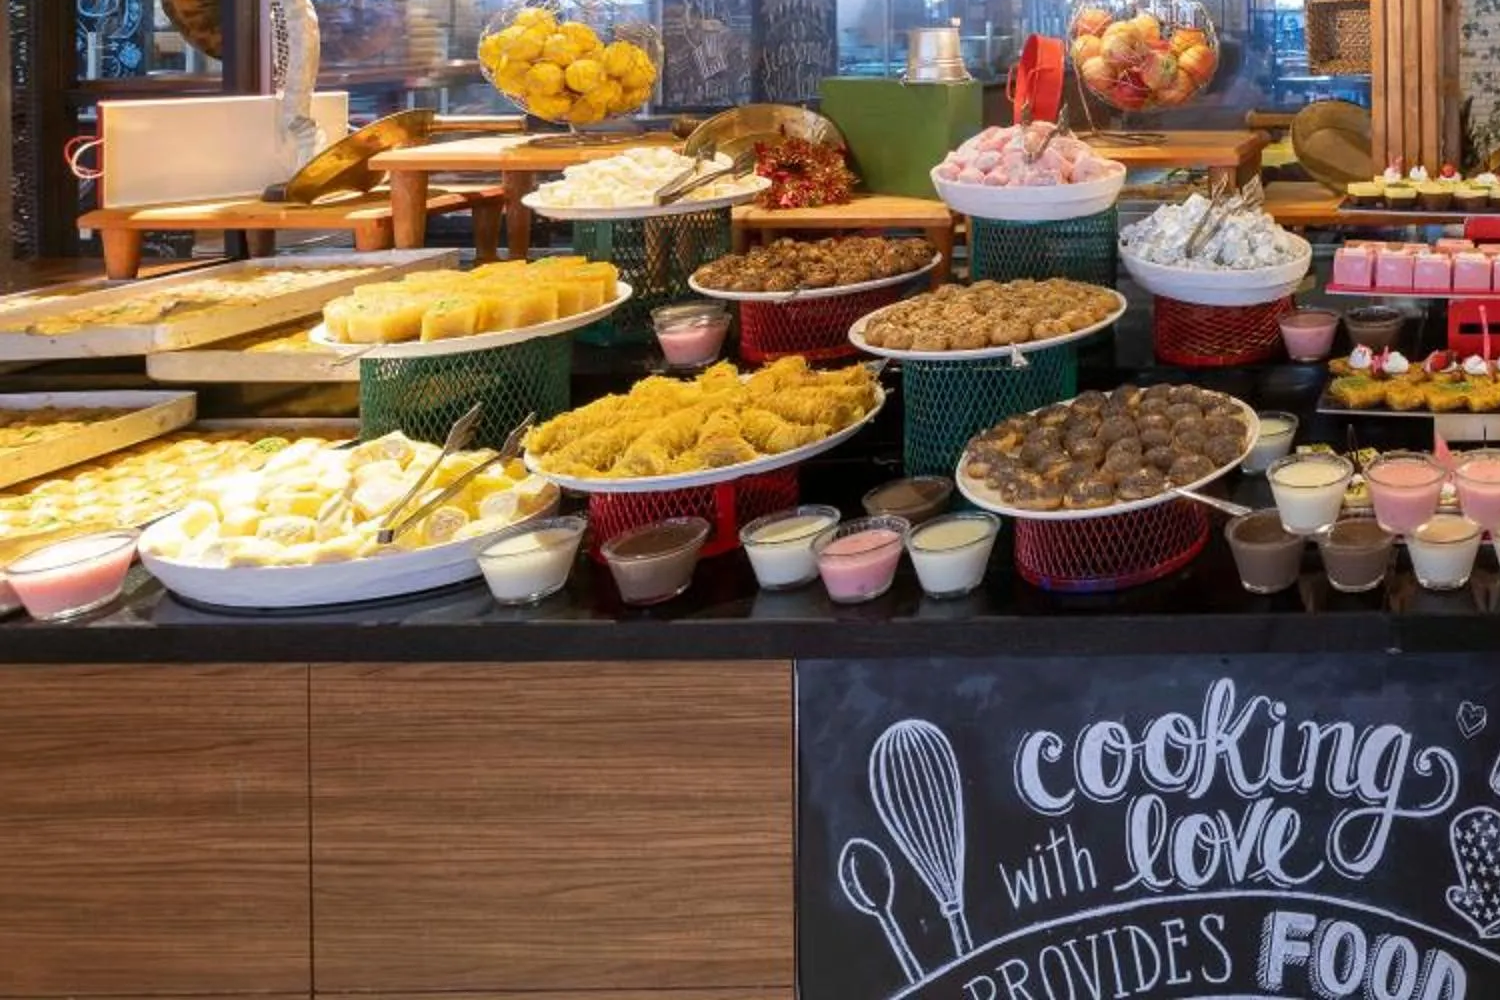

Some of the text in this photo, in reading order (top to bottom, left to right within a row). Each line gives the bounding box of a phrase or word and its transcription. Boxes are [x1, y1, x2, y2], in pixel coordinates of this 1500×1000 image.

[1013, 677, 1459, 880] cooking
[999, 794, 1325, 909] with love
[1256, 909, 1468, 1000] FOOD
